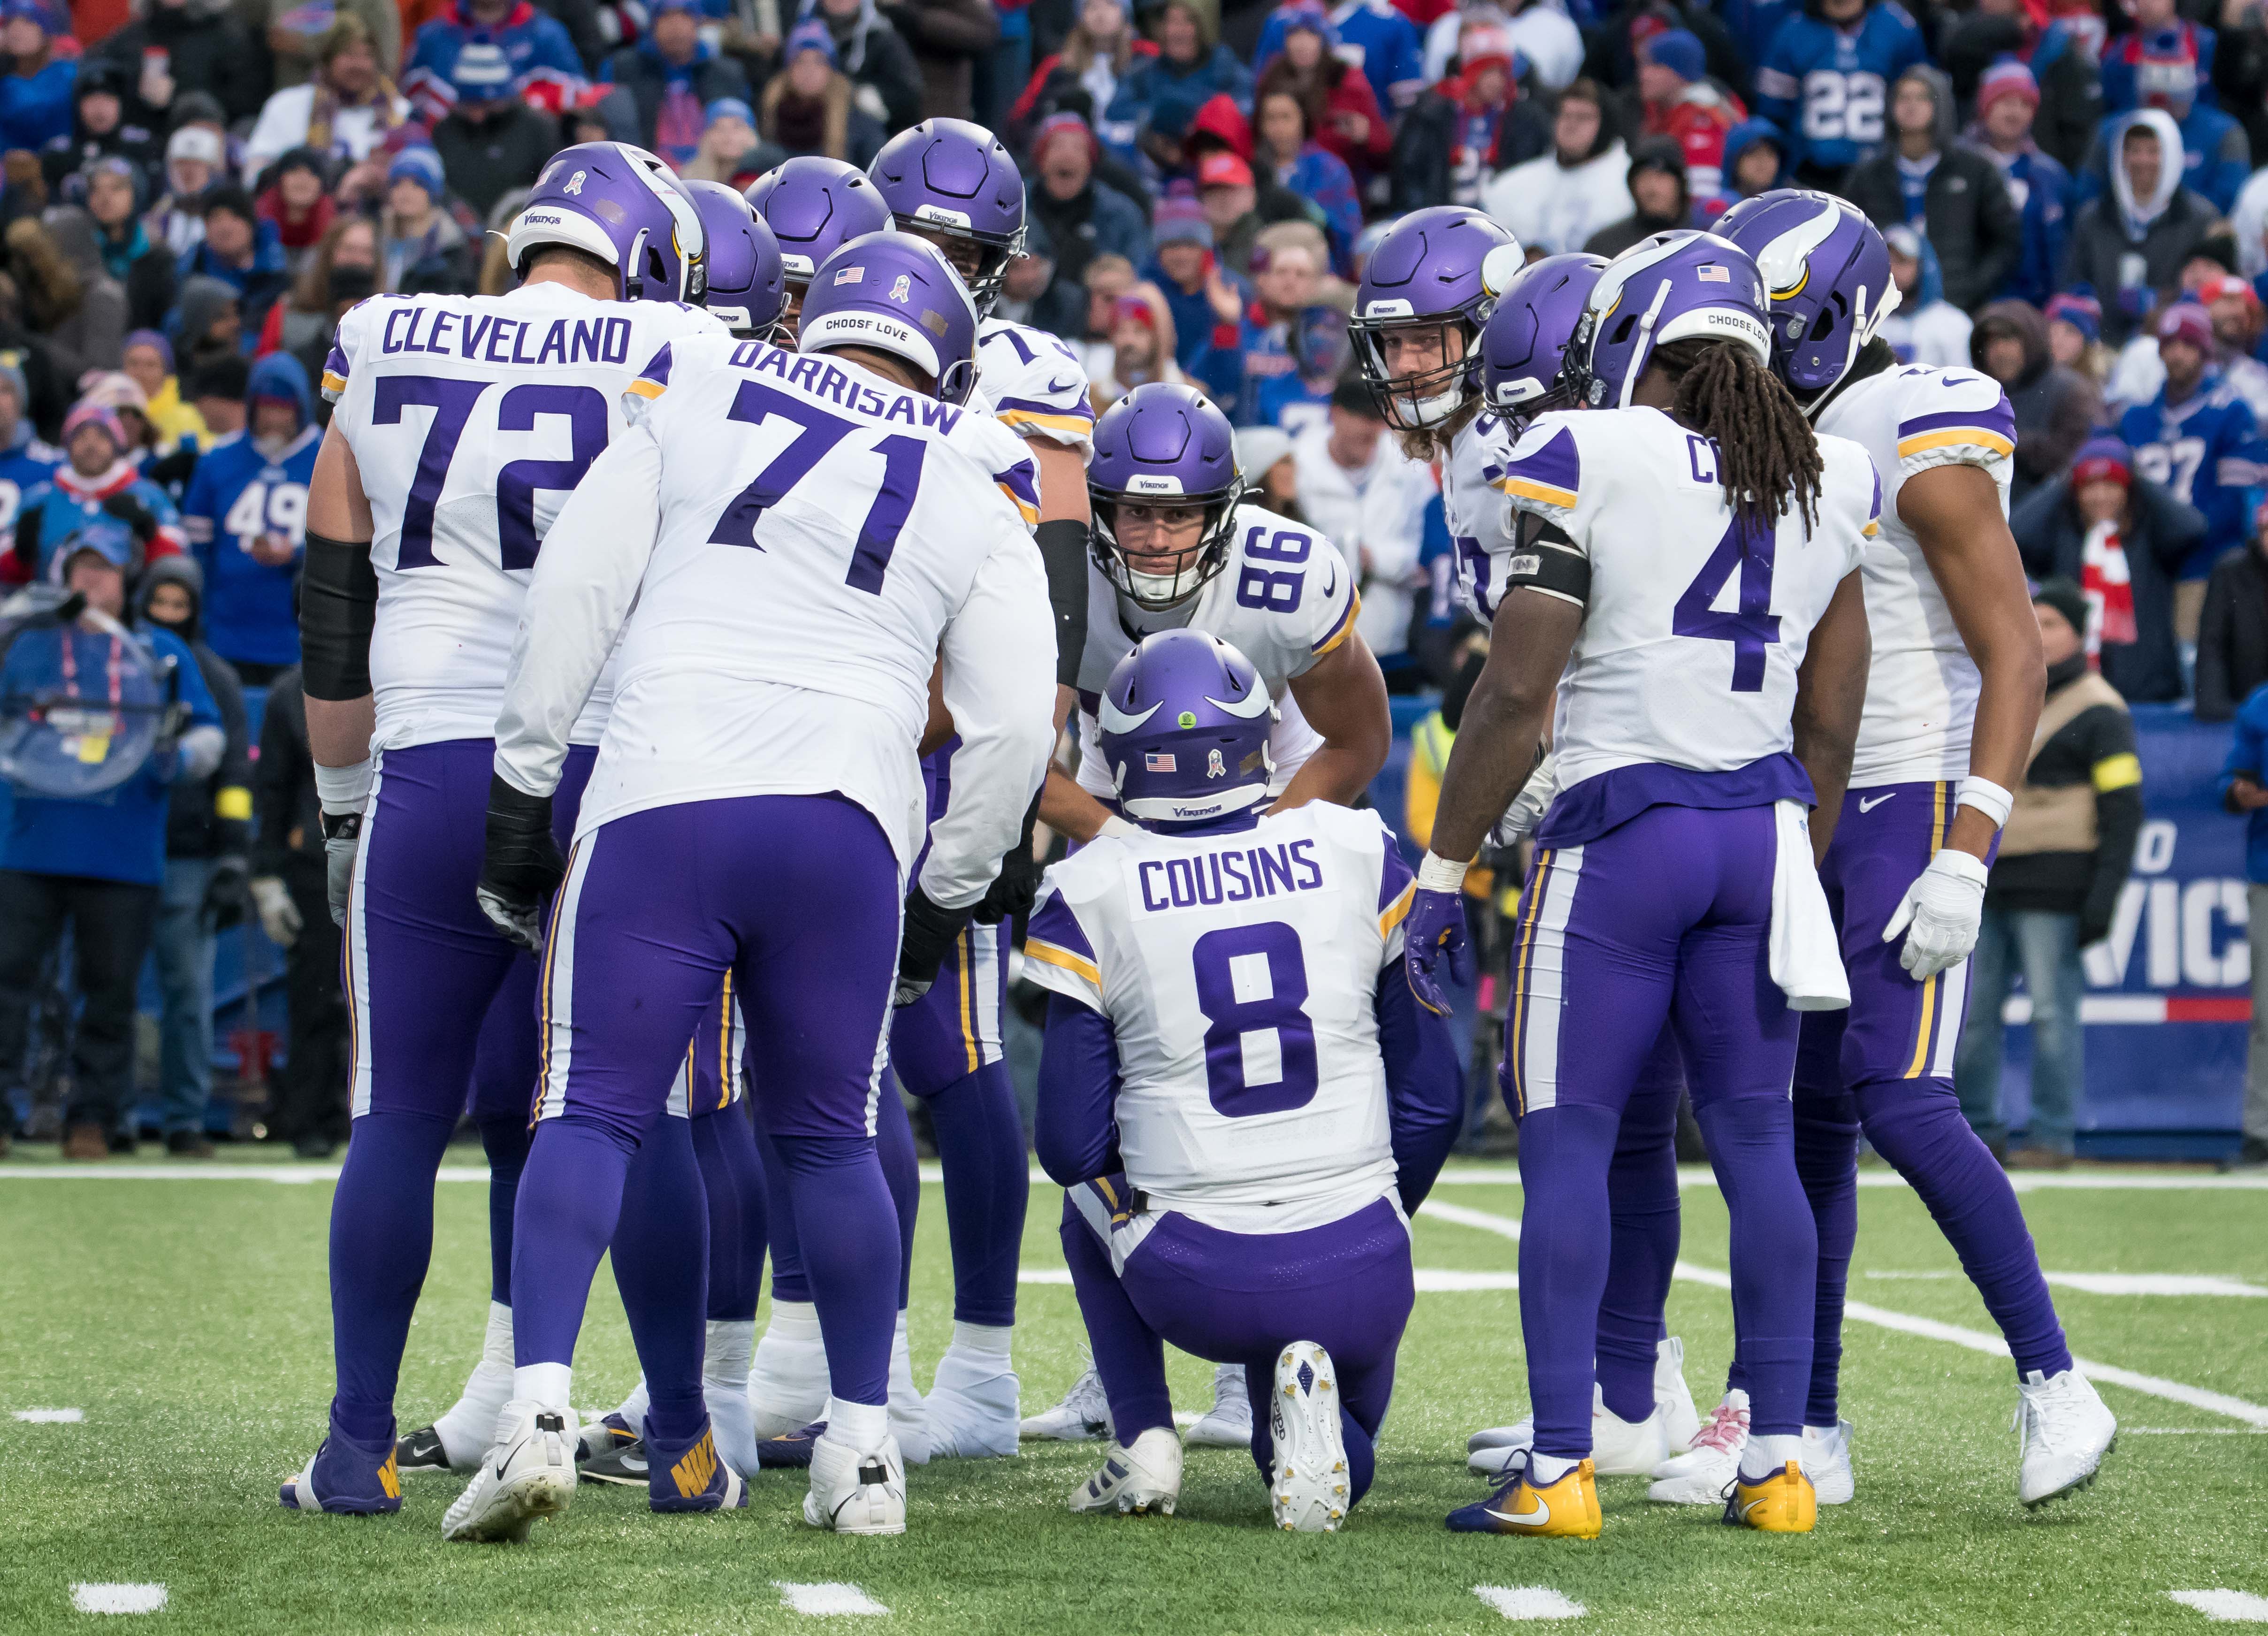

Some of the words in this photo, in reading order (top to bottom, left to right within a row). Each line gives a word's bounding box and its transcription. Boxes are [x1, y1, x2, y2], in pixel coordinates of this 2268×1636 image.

[1803, 70, 1886, 141] 22
[382, 307, 632, 364] CLEVELAND
[876, 322, 908, 341] LOVE
[1708, 315, 1751, 332] CHOOSE
[1753, 326, 1768, 349] LOVE
[728, 341, 963, 437] DARRISAW
[372, 375, 609, 571] 72
[706, 379, 928, 596] 71
[224, 481, 309, 554] 49
[1237, 526, 1312, 613] 86
[1672, 500, 1782, 692] 4
[1138, 839, 1323, 912] COUSINS
[1192, 921, 1319, 1118] 8
